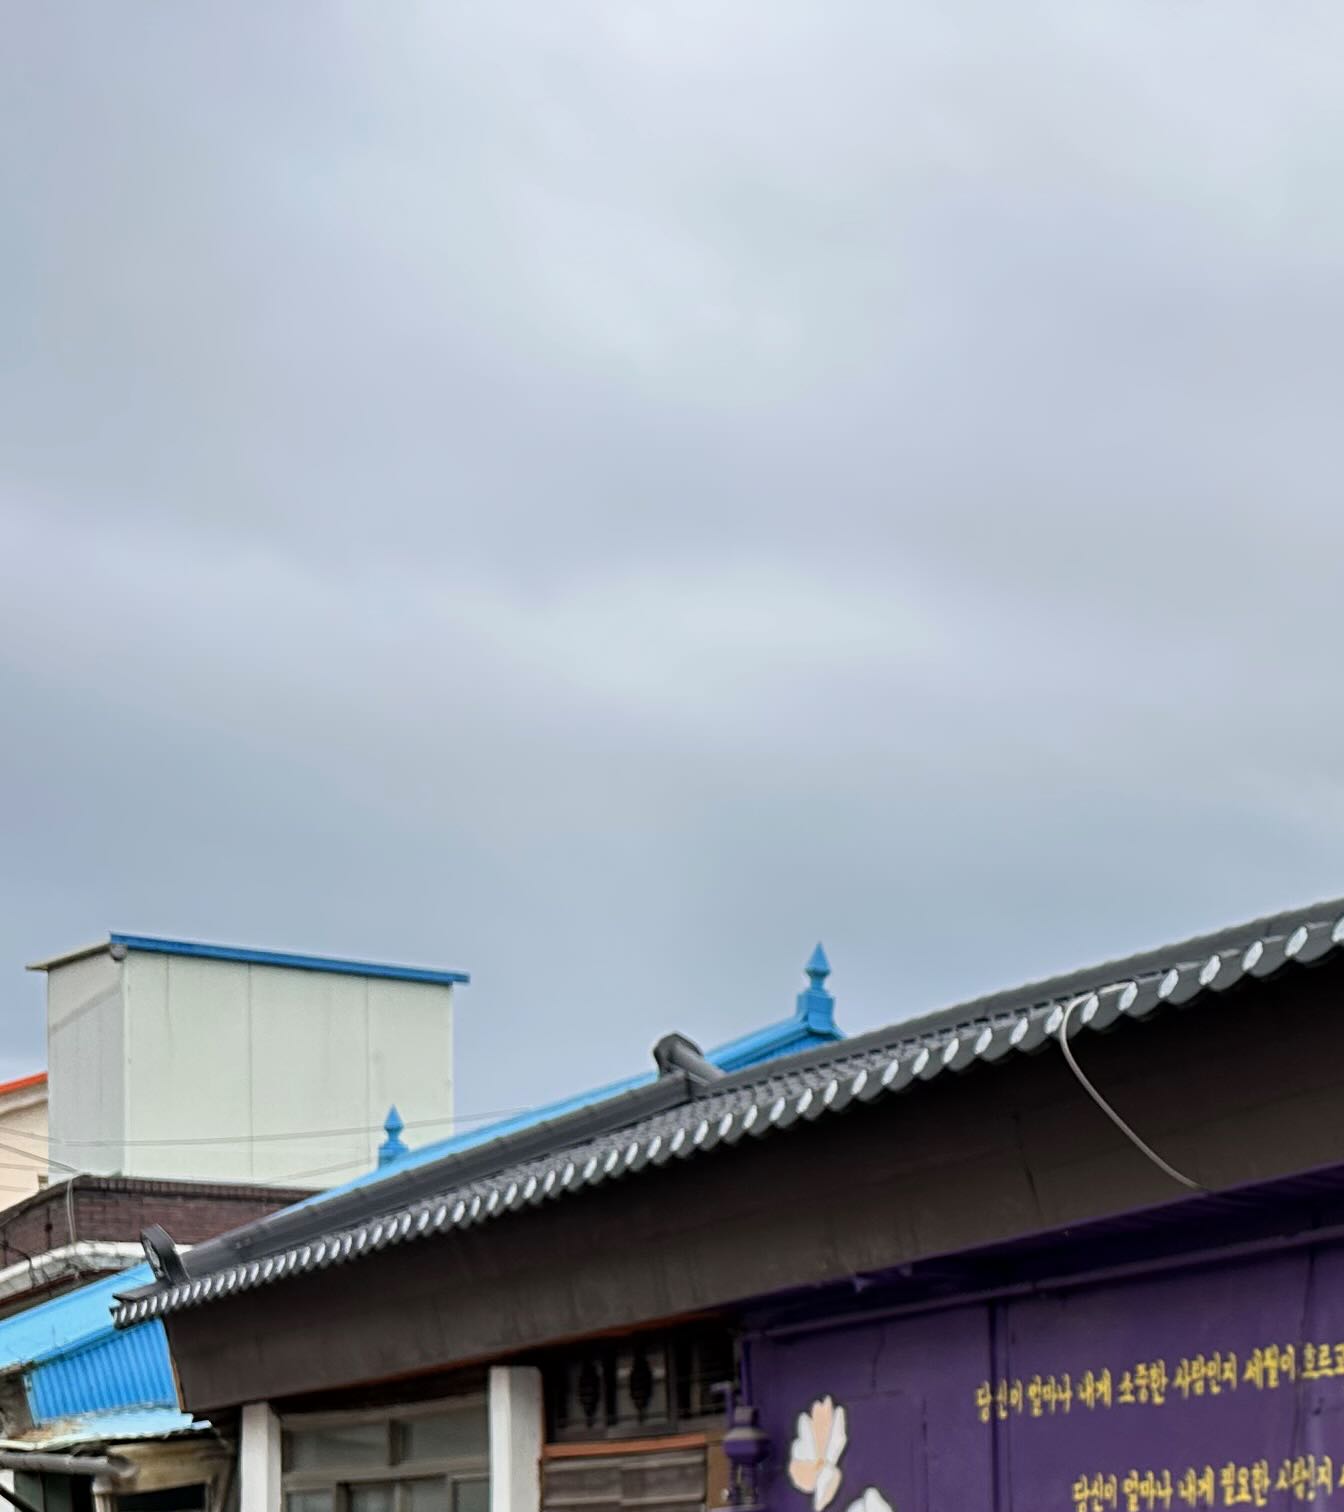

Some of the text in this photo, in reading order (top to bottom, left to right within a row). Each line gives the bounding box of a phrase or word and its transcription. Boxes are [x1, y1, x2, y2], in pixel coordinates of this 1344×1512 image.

[975, 1380, 1024, 1424] 당신이
[1026, 1374, 1074, 1418] 얼마나
[1077, 1367, 1113, 1410] 내게
[1118, 1358, 1170, 1407] 소중한
[1172, 1350, 1238, 1398] 사람인지
[1242, 1342, 1297, 1391] 세월이
[1177, 1464, 1216, 1507] 내게
[1219, 1459, 1272, 1508] 필요한
